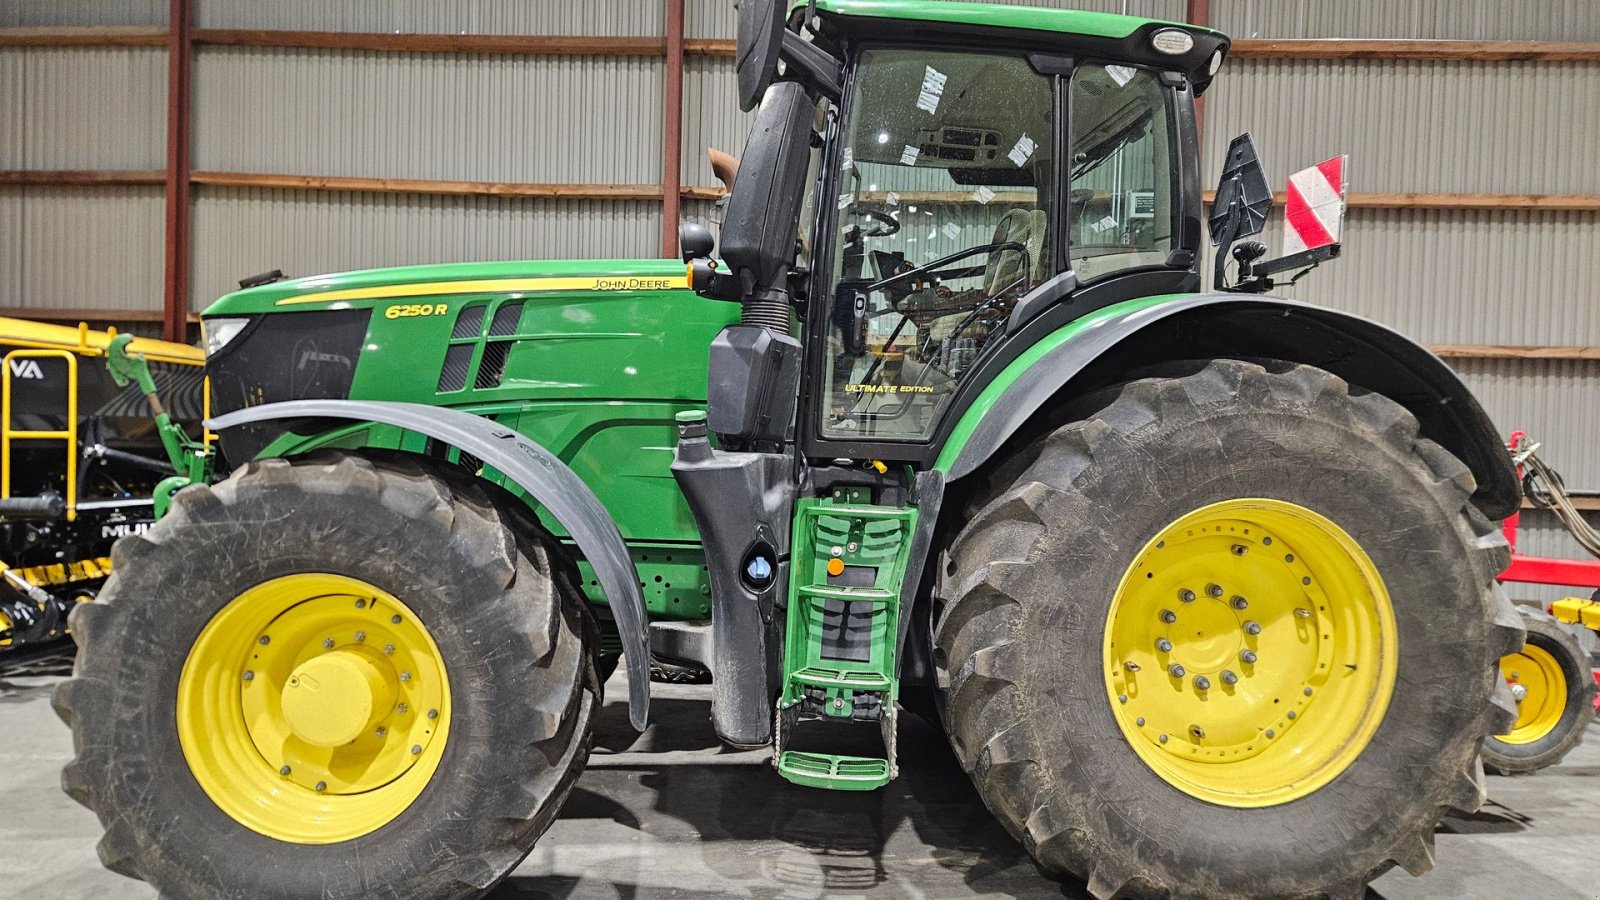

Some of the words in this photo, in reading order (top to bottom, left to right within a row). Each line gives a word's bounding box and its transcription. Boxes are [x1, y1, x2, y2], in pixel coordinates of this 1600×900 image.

[592, 279, 626, 289] JOHN
[629, 278, 671, 289] DEERE
[384, 303, 434, 319] 6250
[0, 357, 44, 379] VA
[844, 384, 898, 393] ULTIMATE
[899, 385, 934, 393] EDITION
